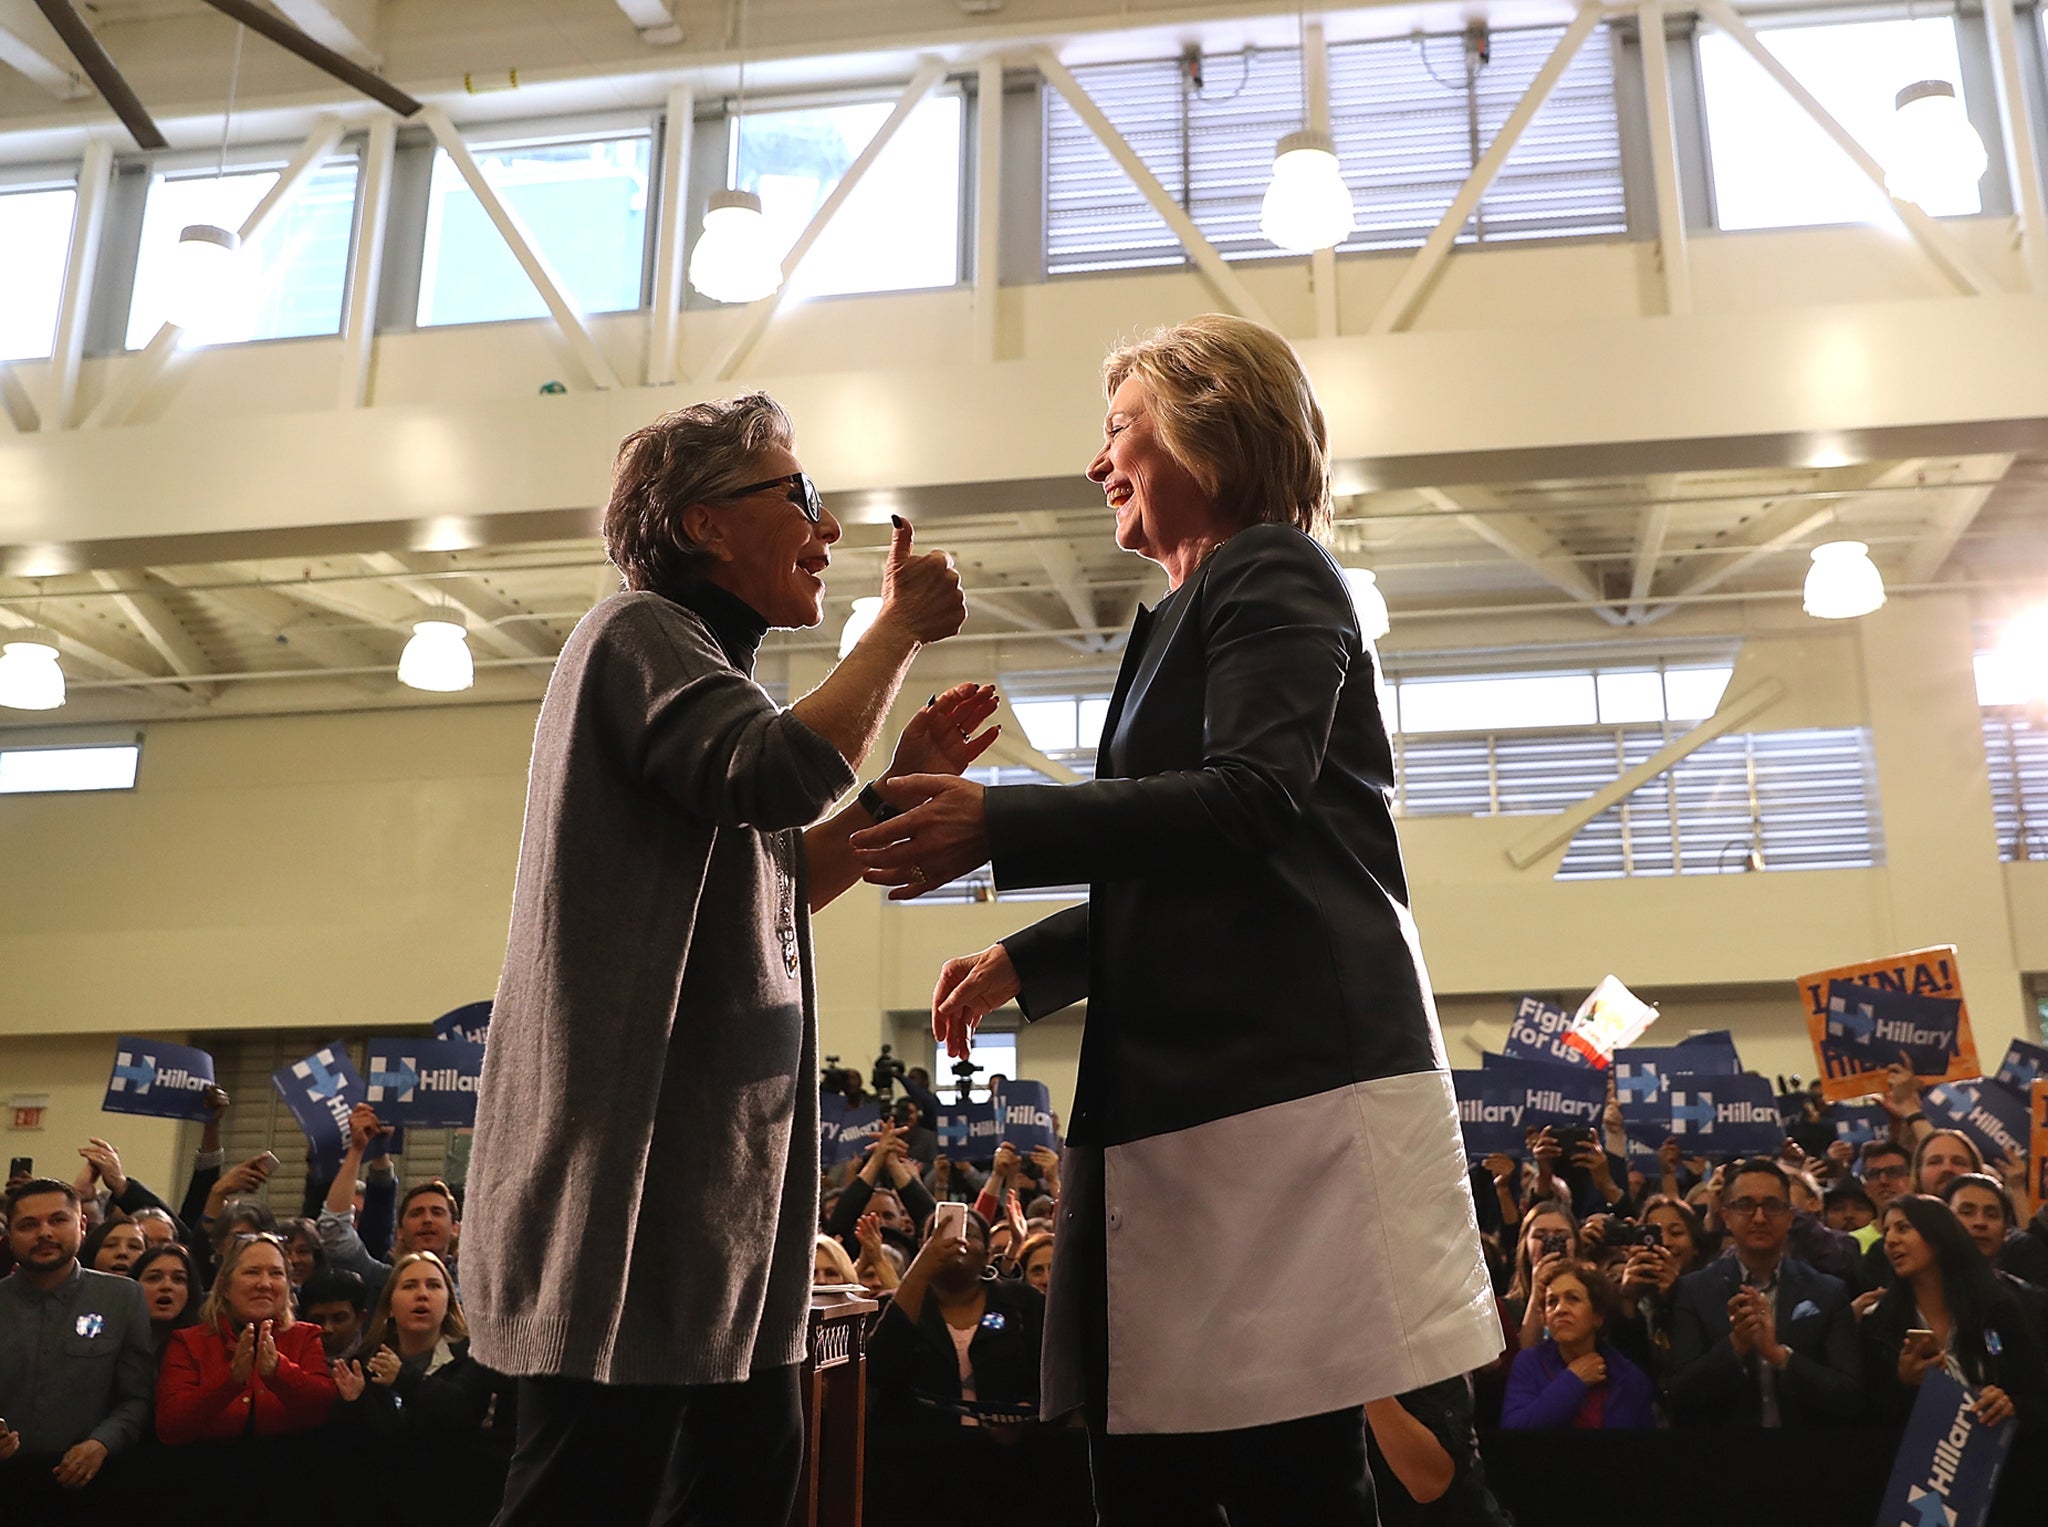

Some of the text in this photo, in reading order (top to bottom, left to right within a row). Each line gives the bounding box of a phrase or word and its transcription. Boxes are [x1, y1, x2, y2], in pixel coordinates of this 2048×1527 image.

[1519, 997, 1573, 1034] Figh
[1511, 1018, 1581, 1063] for us
[1875, 1018, 1952, 1049] Hillary
[155, 1067, 215, 1092] Hillar
[420, 1069, 482, 1092] Hillar
[1526, 1089, 1602, 1122] Hillary
[1717, 1101, 1784, 1128] Hillary
[1968, 1105, 2028, 1158] Hillary
[1936, 1390, 1976, 1496] Hillary
